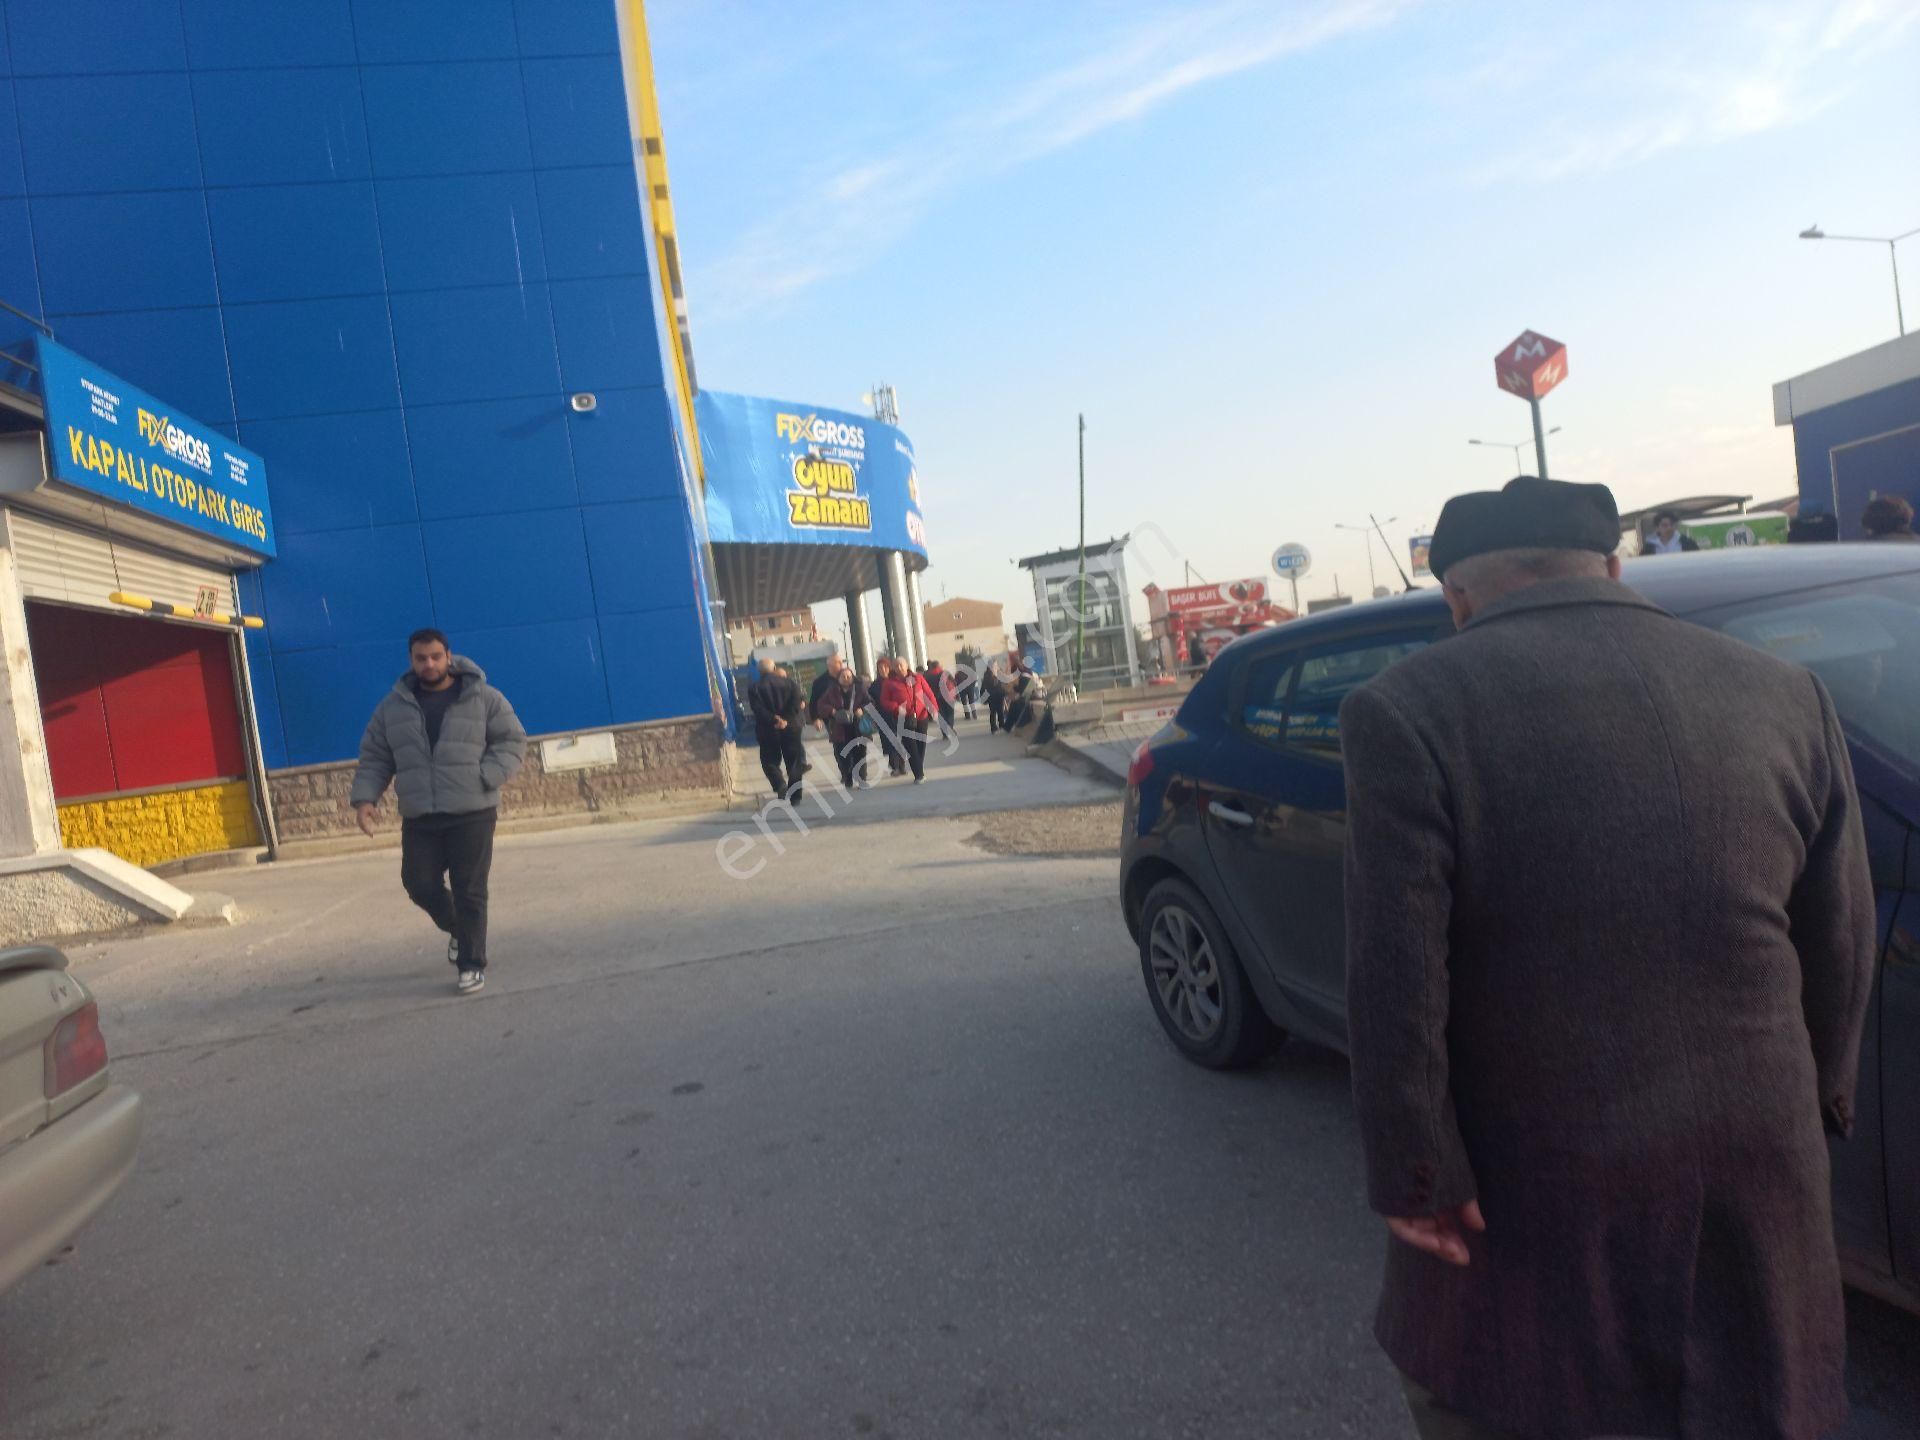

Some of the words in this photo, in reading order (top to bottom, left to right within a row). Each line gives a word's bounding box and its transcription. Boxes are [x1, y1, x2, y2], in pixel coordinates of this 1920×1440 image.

[68, 425, 149, 493] KAPALI
[151, 463, 231, 525] OTOPARK
[230, 498, 266, 543] GİRİŞ
